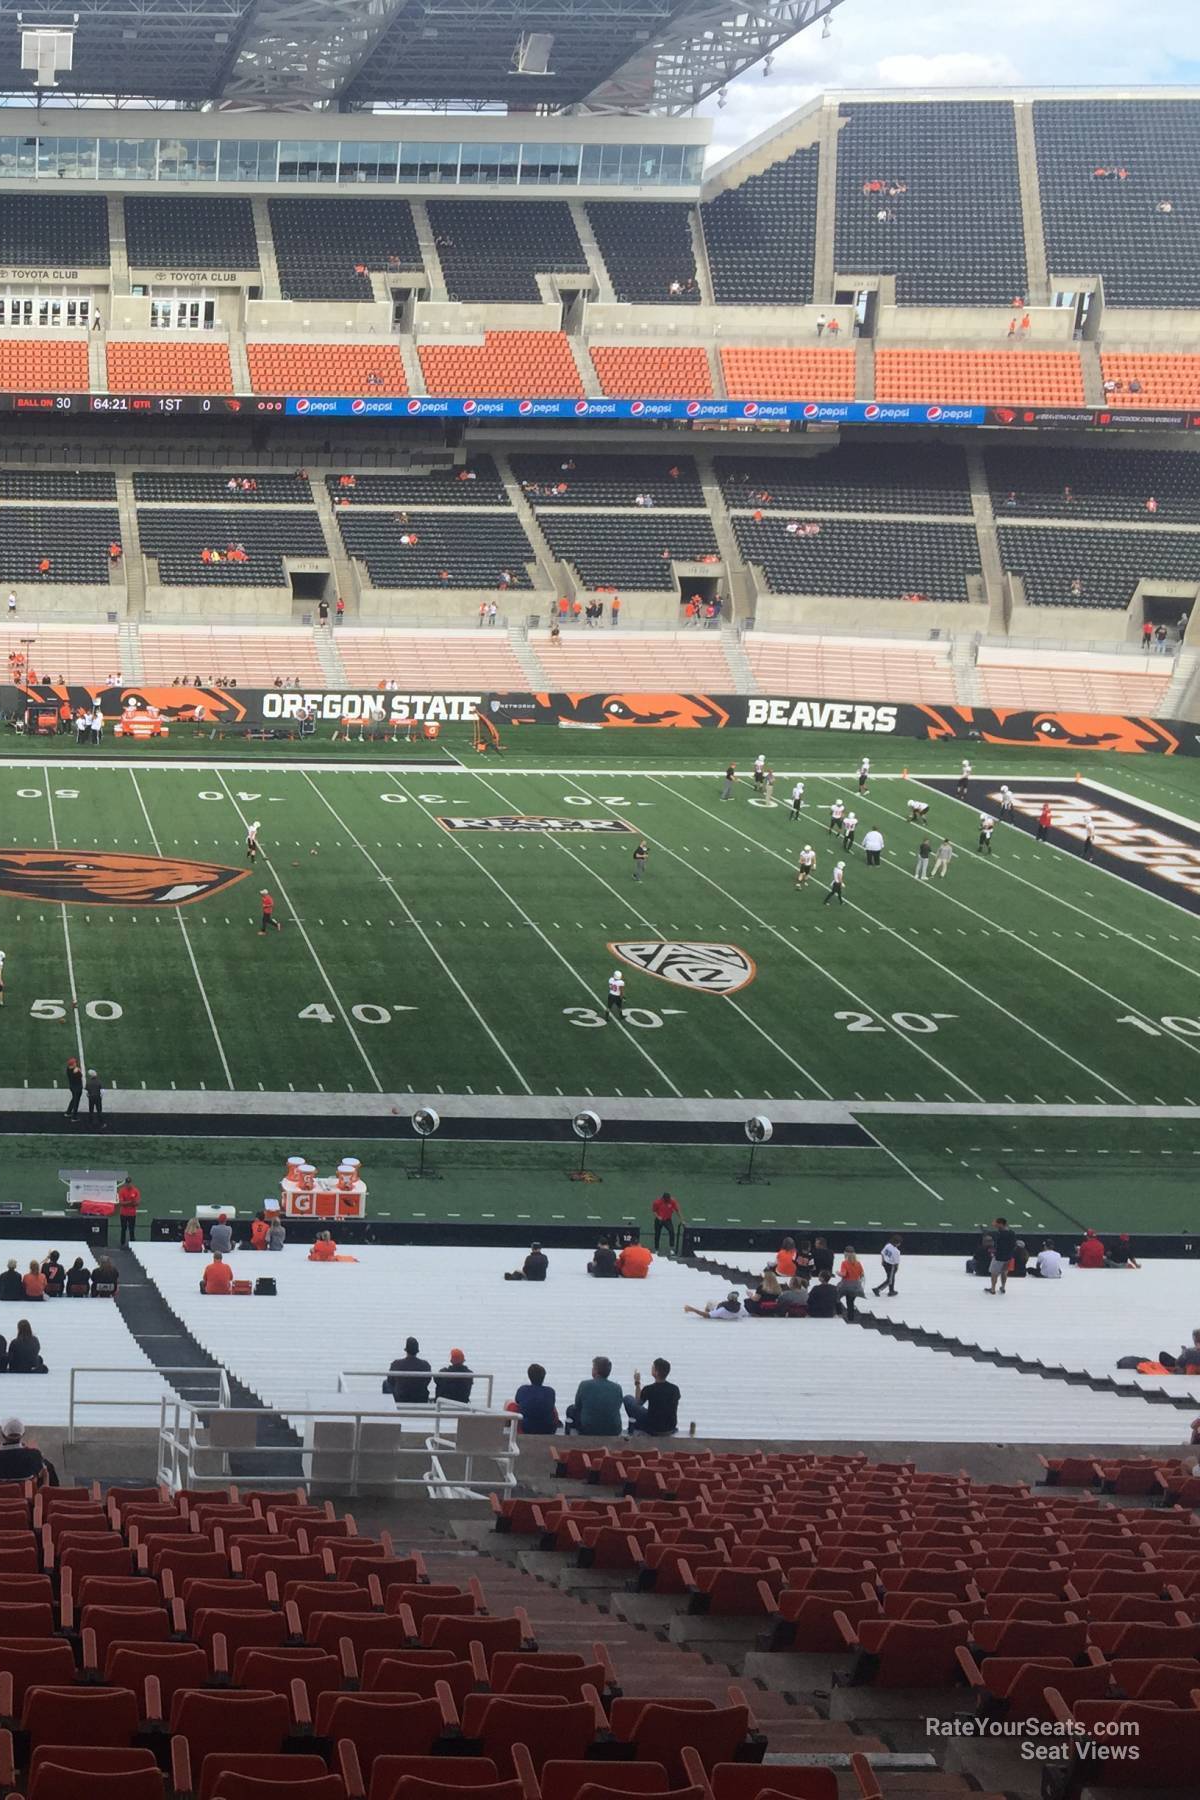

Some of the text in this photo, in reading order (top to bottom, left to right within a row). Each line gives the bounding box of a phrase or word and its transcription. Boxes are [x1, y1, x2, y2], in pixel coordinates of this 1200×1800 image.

[11, 270, 78, 279] TOYOTA CLUB
[171, 272, 236, 281] TOYOTA CLUB
[56, 398, 71, 408] 30
[94, 398, 128, 410] 64:21
[159, 399, 182, 410] 1ST
[203, 400, 210, 410] 0
[311, 402, 336, 413] pepsi
[366, 402, 392, 413] pepsi
[422, 403, 448, 414] pepsi
[477, 403, 504, 414] pepsi
[533, 403, 560, 414] pepsi
[589, 404, 616, 414] pepsi
[645, 404, 672, 415] pepsi
[700, 404, 728, 416] pepsi
[759, 405, 787, 417] pepsi
[819, 406, 848, 418] pepsi
[880, 407, 910, 419] pepsi
[943, 408, 972, 420] pepsi
[262, 694, 482, 720] OREGON STATE
[747, 700, 898, 732] BEAVERS
[450, 818, 625, 831] RESER
[30, 1000, 124, 1020] 50
[298, 1003, 392, 1024] 40
[562, 1007, 664, 1028] 30
[833, 1012, 939, 1033] 20
[1116, 1015, 1200, 1036] 10
[295, 1195, 310, 1211] G
